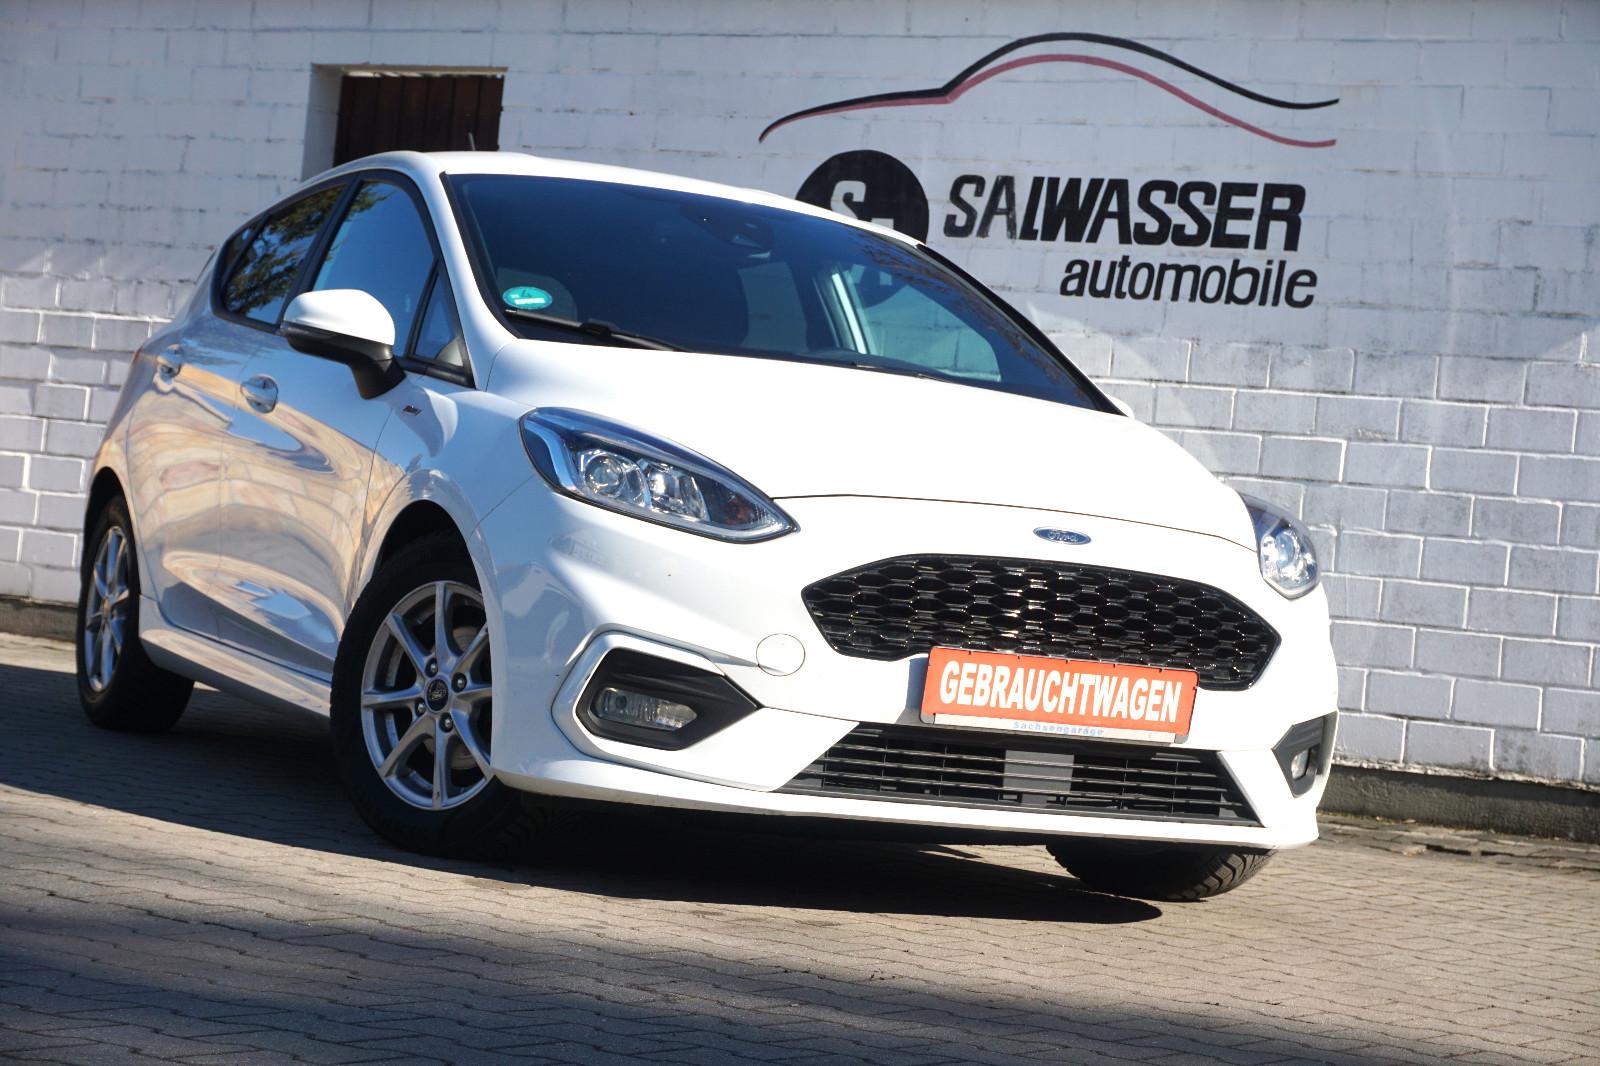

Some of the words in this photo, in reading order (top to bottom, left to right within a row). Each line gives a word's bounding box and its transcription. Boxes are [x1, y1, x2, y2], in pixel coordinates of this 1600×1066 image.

[944, 175, 1306, 251] SALWASSER
[1060, 255, 1318, 309] automobile
[939, 660, 1183, 723] GEBRAUCHTWAGEN
